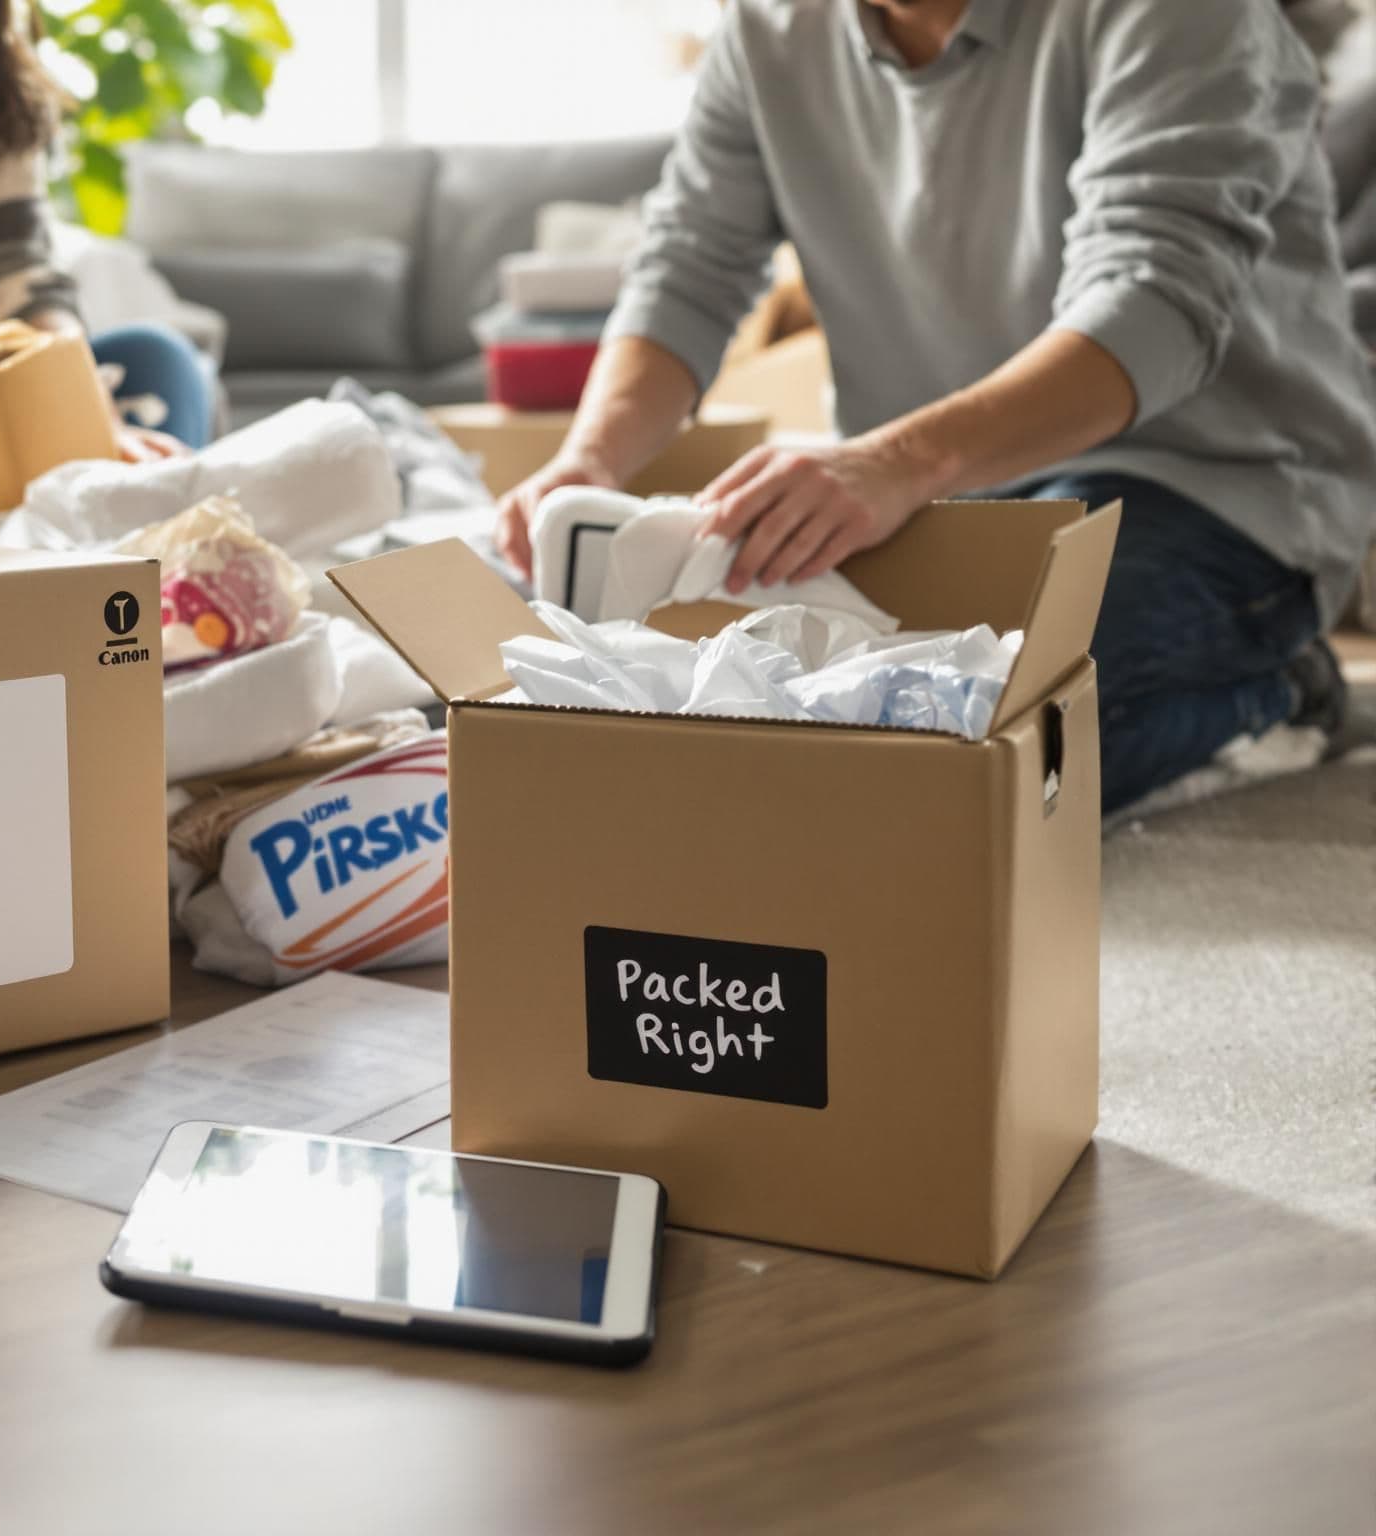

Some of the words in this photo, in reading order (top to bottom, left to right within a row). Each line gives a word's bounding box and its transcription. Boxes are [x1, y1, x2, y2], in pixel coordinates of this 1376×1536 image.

[98, 648, 150, 666] Canon
[616, 959, 786, 1014] Packed
[636, 1012, 775, 1074] Right
